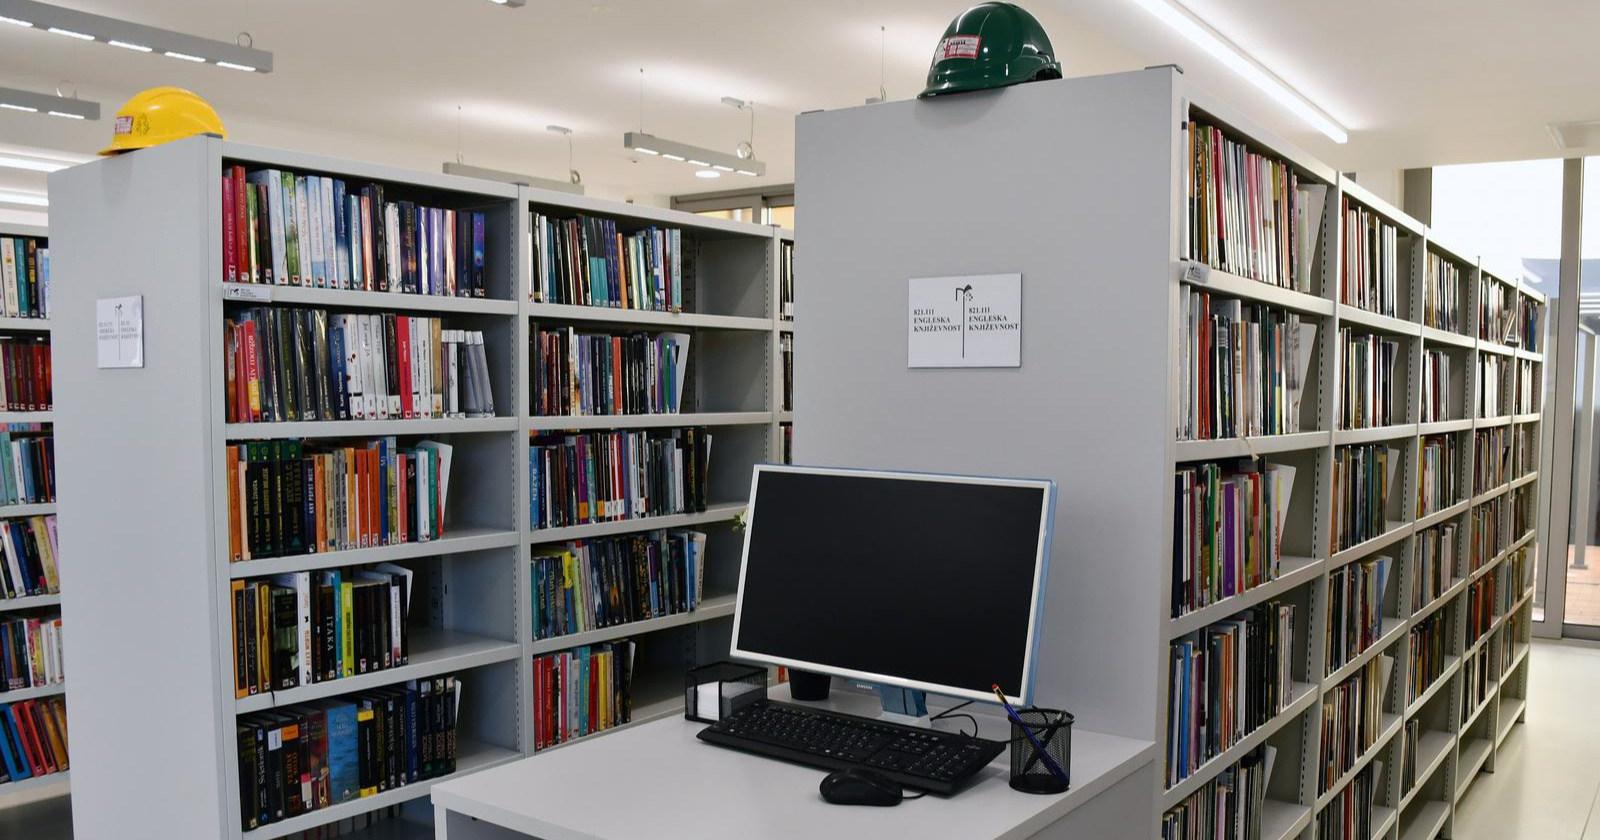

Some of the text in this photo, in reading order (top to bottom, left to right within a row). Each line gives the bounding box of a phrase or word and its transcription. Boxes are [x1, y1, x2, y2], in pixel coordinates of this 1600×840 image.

[913, 323, 961, 332] KNJIŽEVNOST
[968, 322, 1019, 331] KNJIŽEVNOST
[326, 616, 334, 651] ITAKA
[257, 745, 265, 784] Svjetionik
